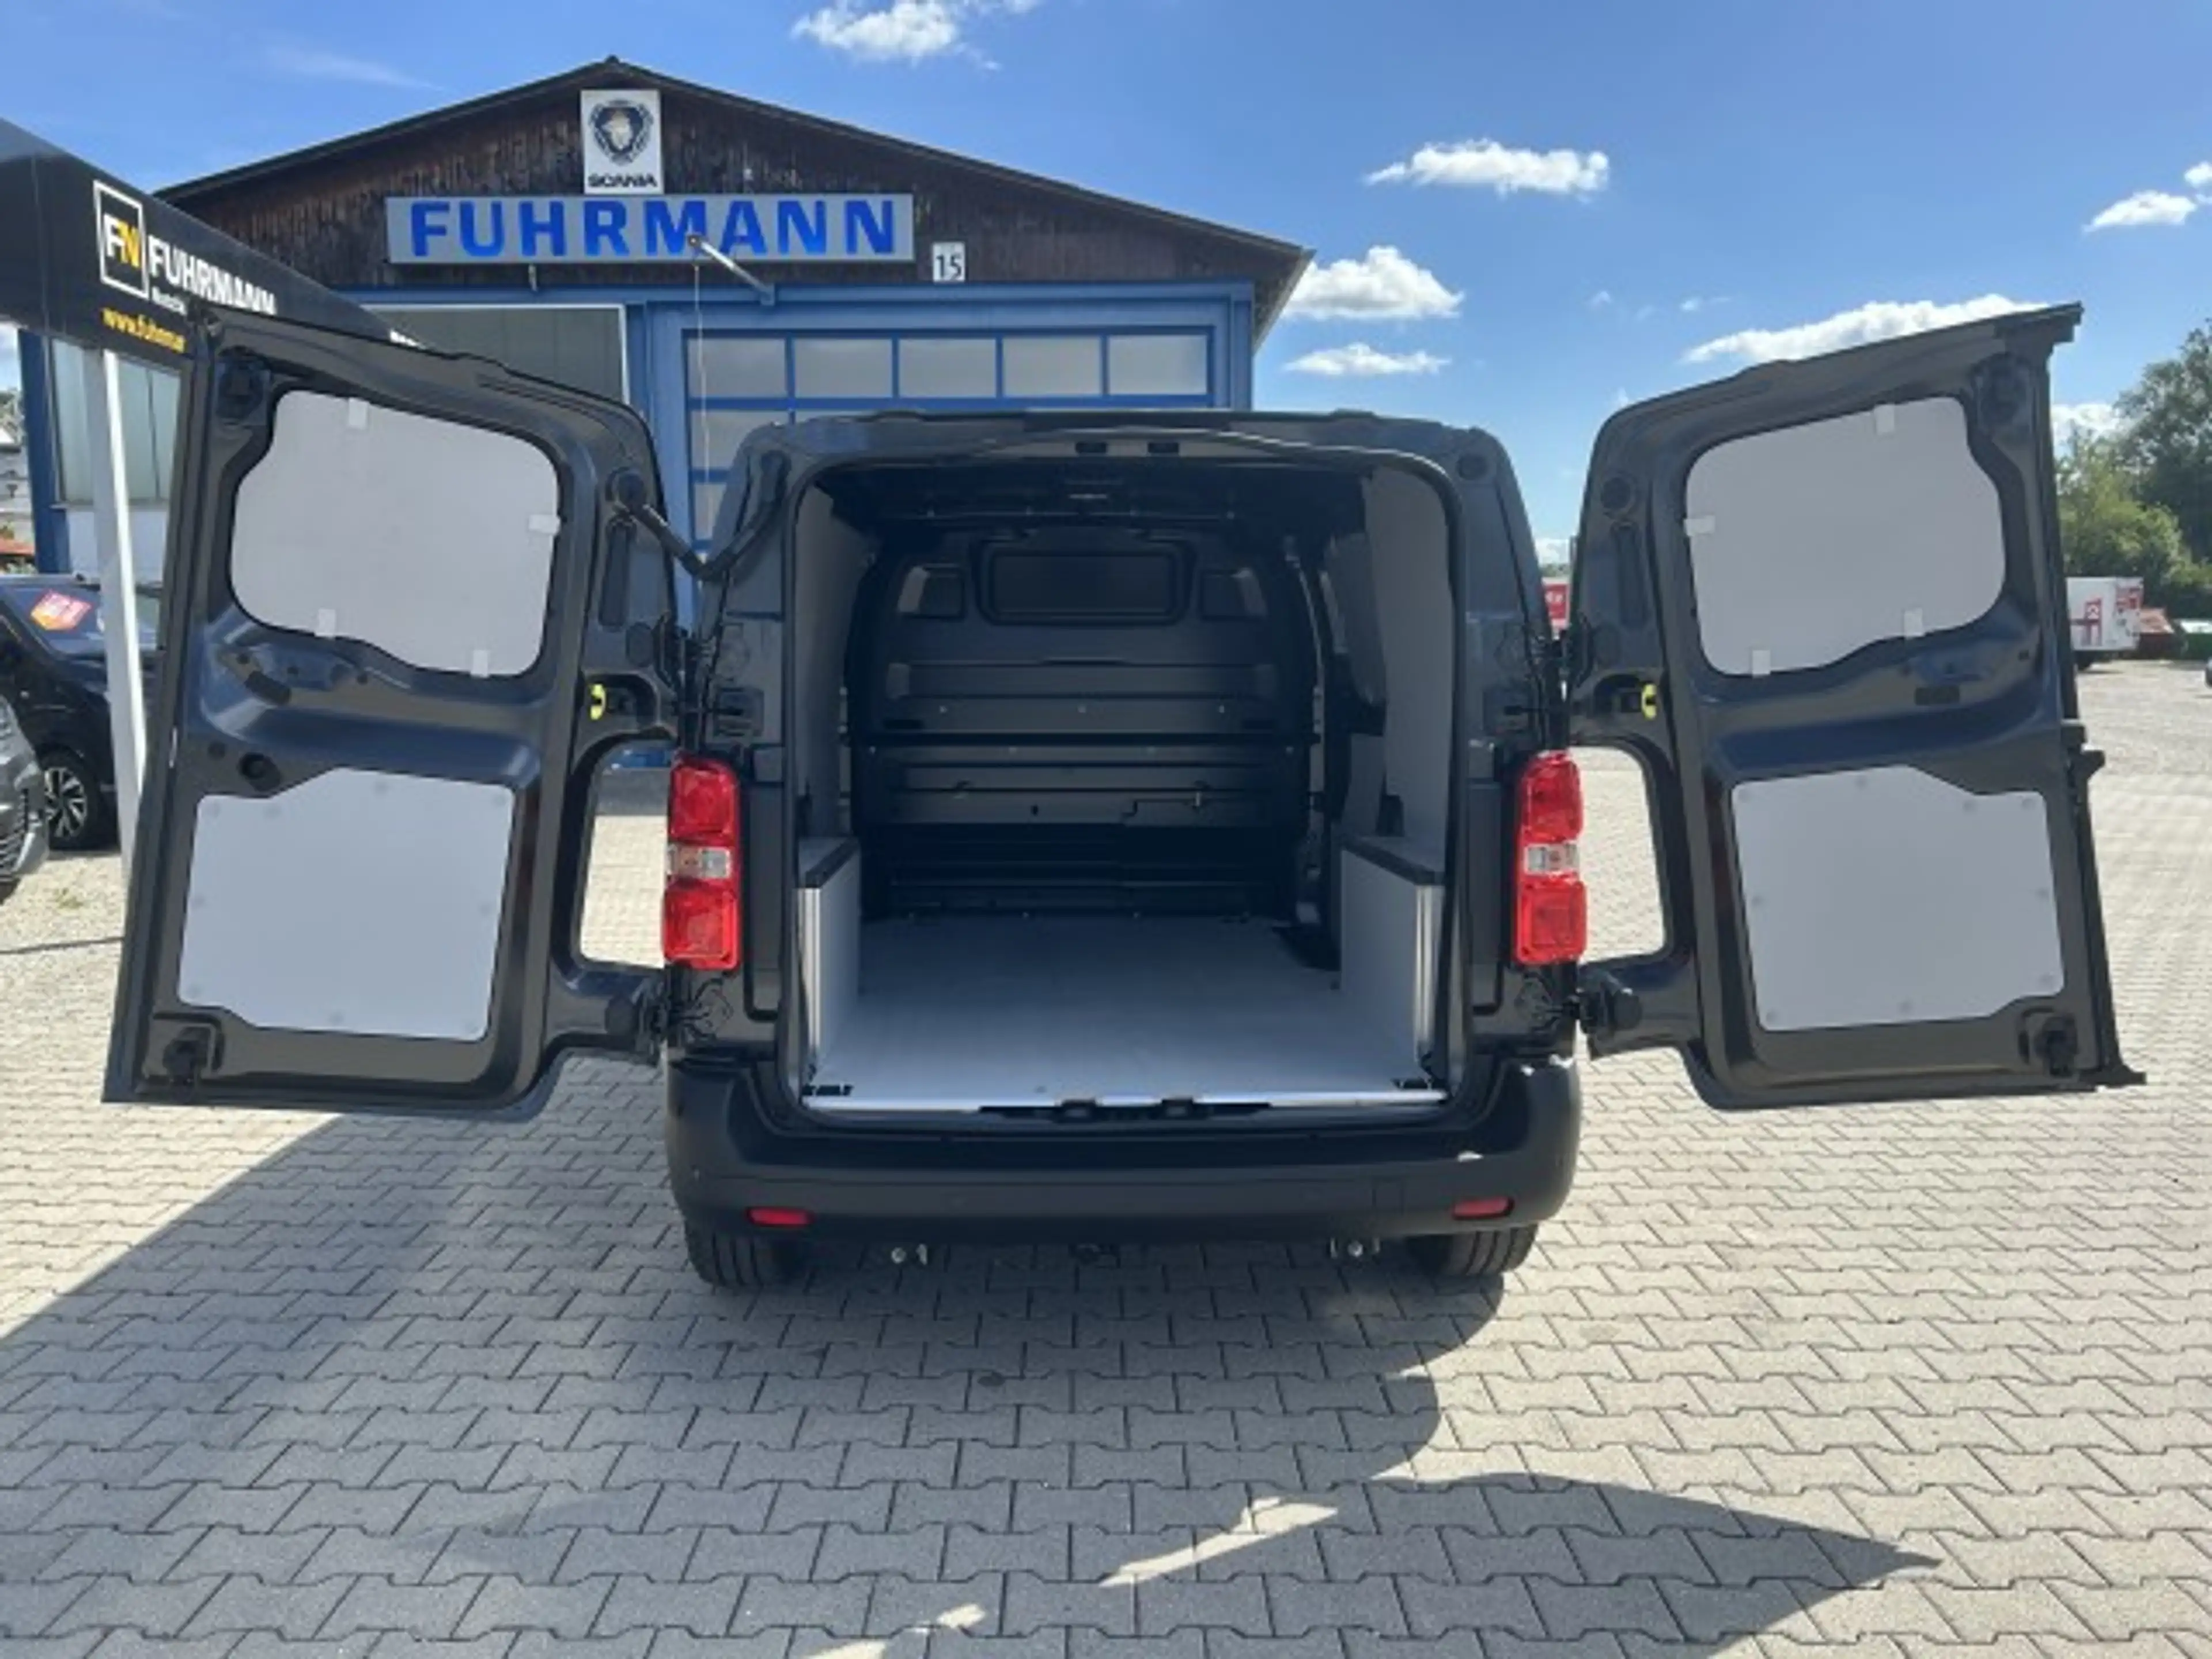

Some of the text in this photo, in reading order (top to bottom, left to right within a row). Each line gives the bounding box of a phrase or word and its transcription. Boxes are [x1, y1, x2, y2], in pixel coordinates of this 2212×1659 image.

[588, 172, 658, 188] SCANIA
[410, 199, 895, 257] FUHRMANN
[147, 234, 277, 316] FUHRMANN
[935, 253, 962, 281] 15
